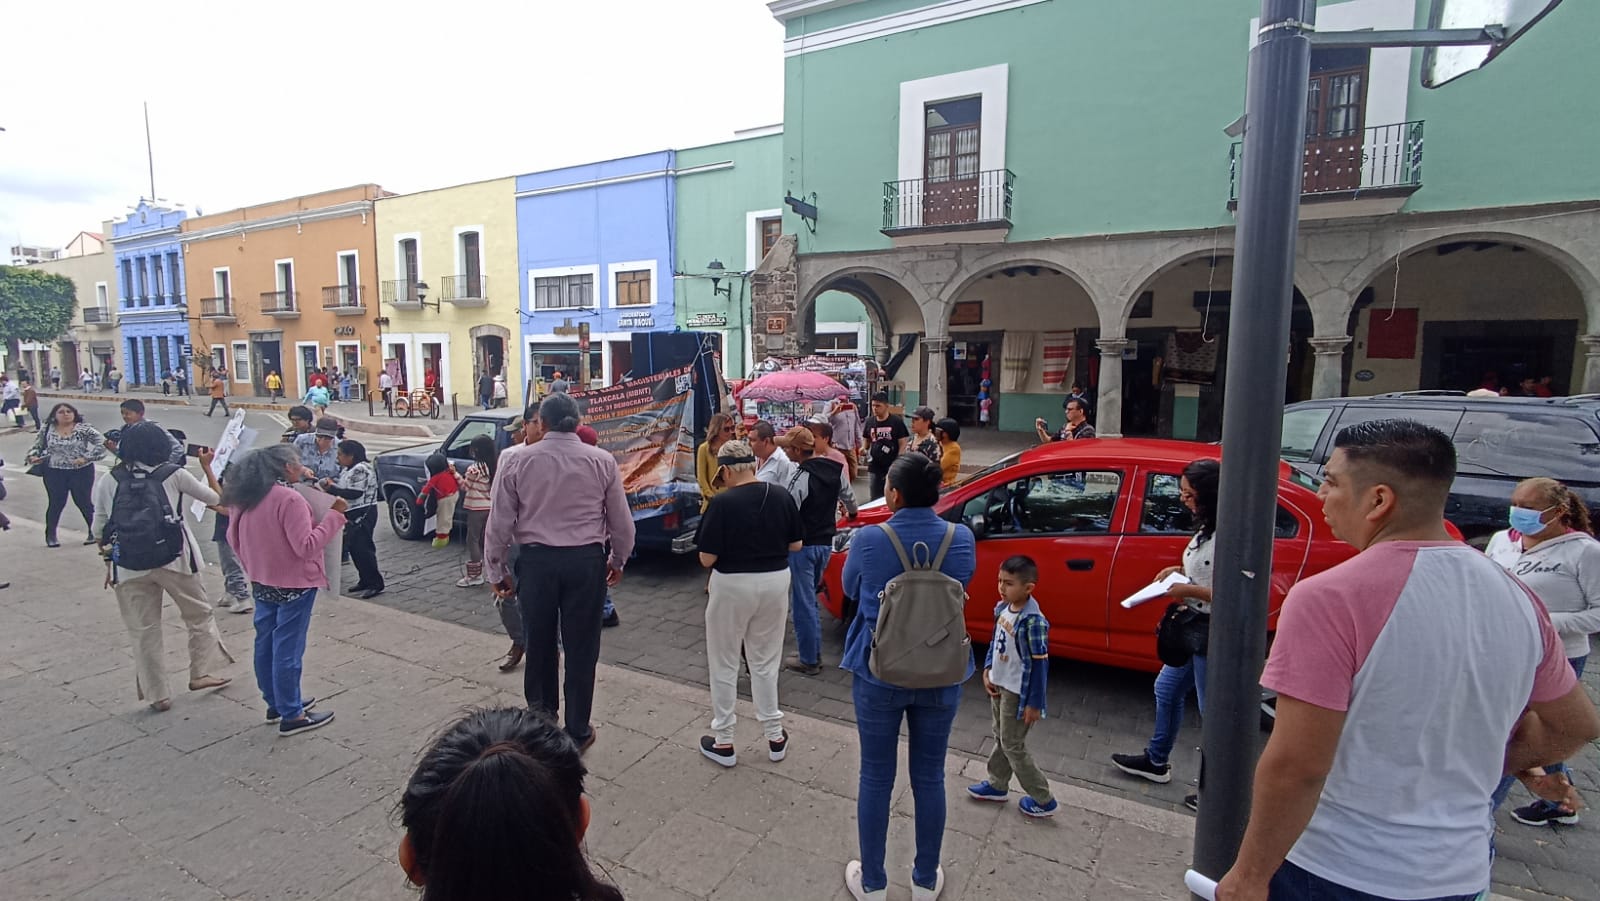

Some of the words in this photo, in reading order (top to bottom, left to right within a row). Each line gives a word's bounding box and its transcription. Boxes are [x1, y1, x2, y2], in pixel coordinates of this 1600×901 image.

[180, 344, 192, 356] E
[626, 371, 681, 388] MAGISTERIALES
[589, 393, 625, 405] TLAXCALA
[626, 387, 651, 400] (MBMT)
[587, 406, 605, 414] SECC.
[590, 412, 609, 422] LUCHA
[1517, 561, 1561, 575] York
